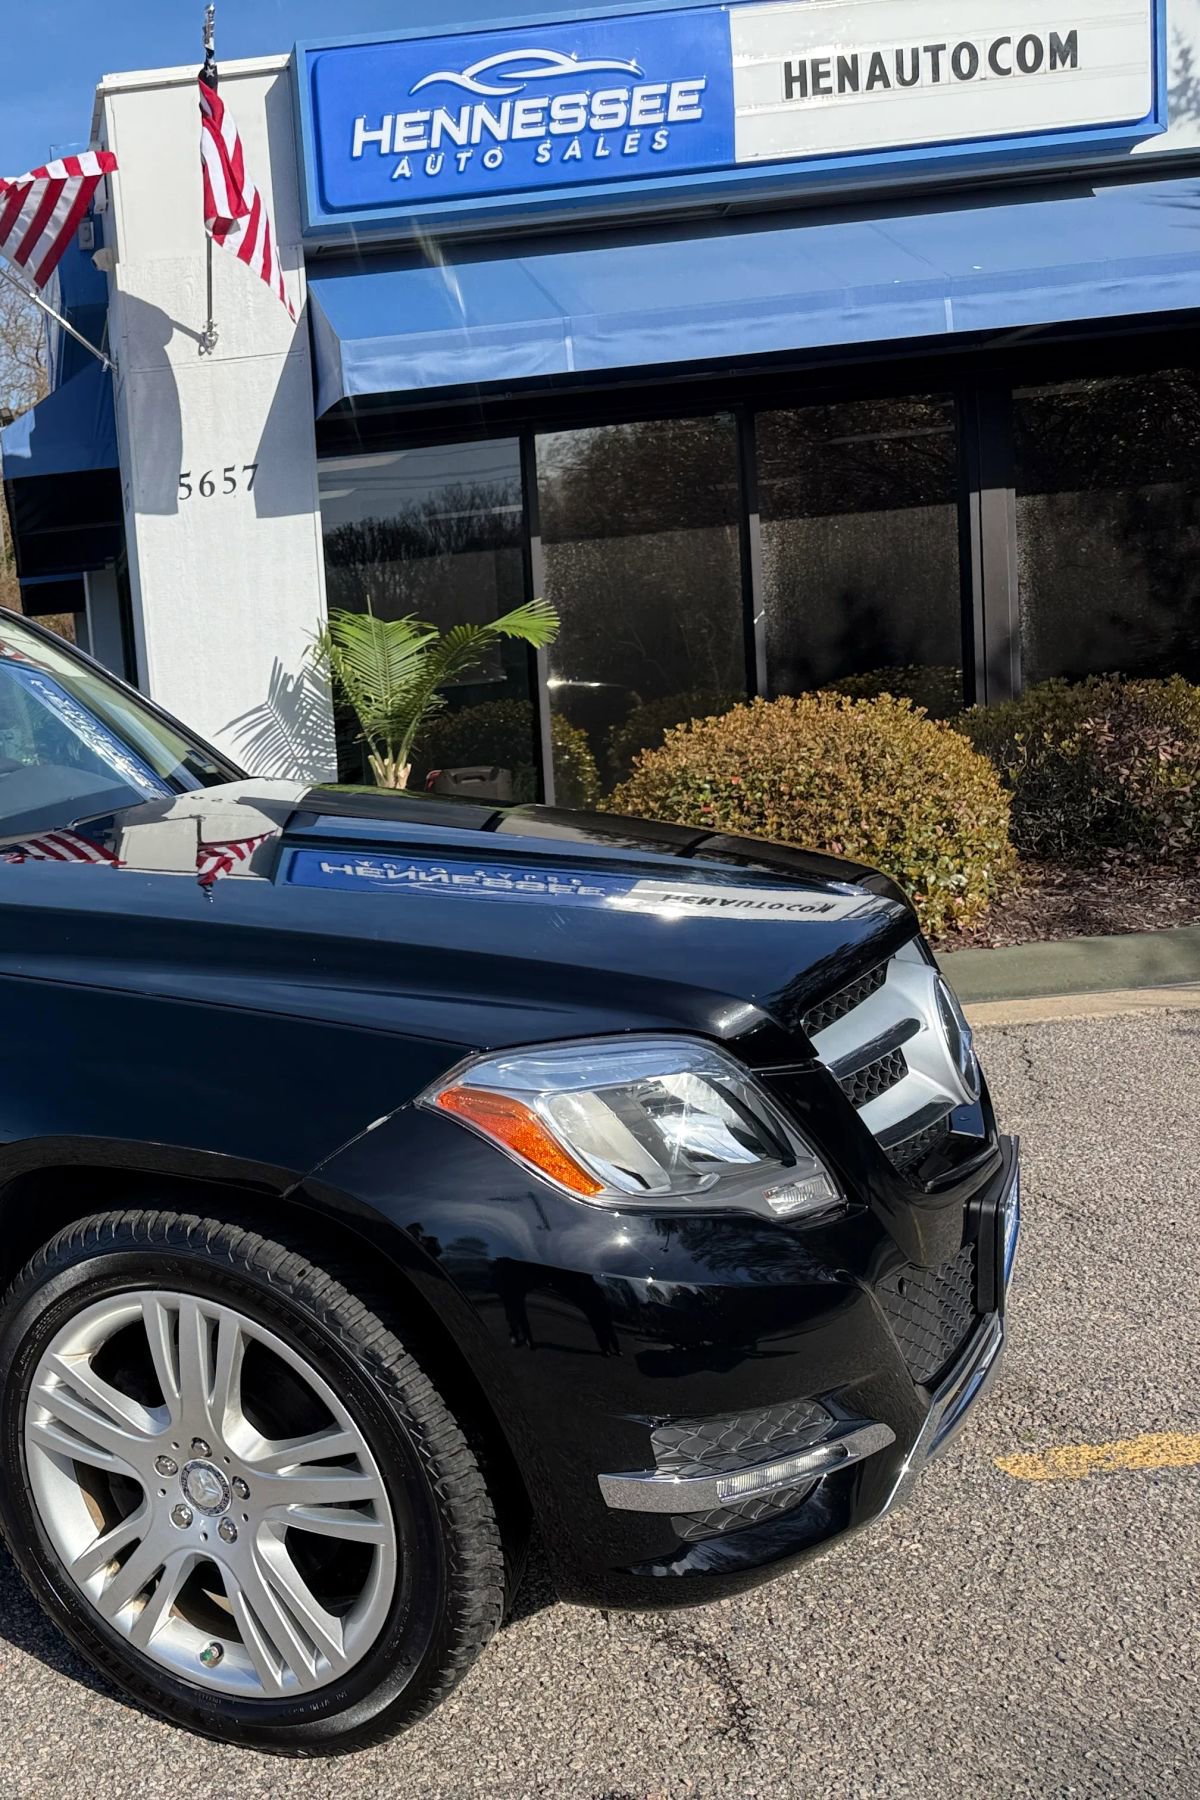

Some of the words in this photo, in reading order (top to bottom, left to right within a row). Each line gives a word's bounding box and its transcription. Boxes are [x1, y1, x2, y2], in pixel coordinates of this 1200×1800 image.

[352, 78, 706, 158] HENNESSEE
[392, 147, 504, 180] AUTO
[535, 129, 669, 164] SALES
[178, 463, 259, 501] 5657
